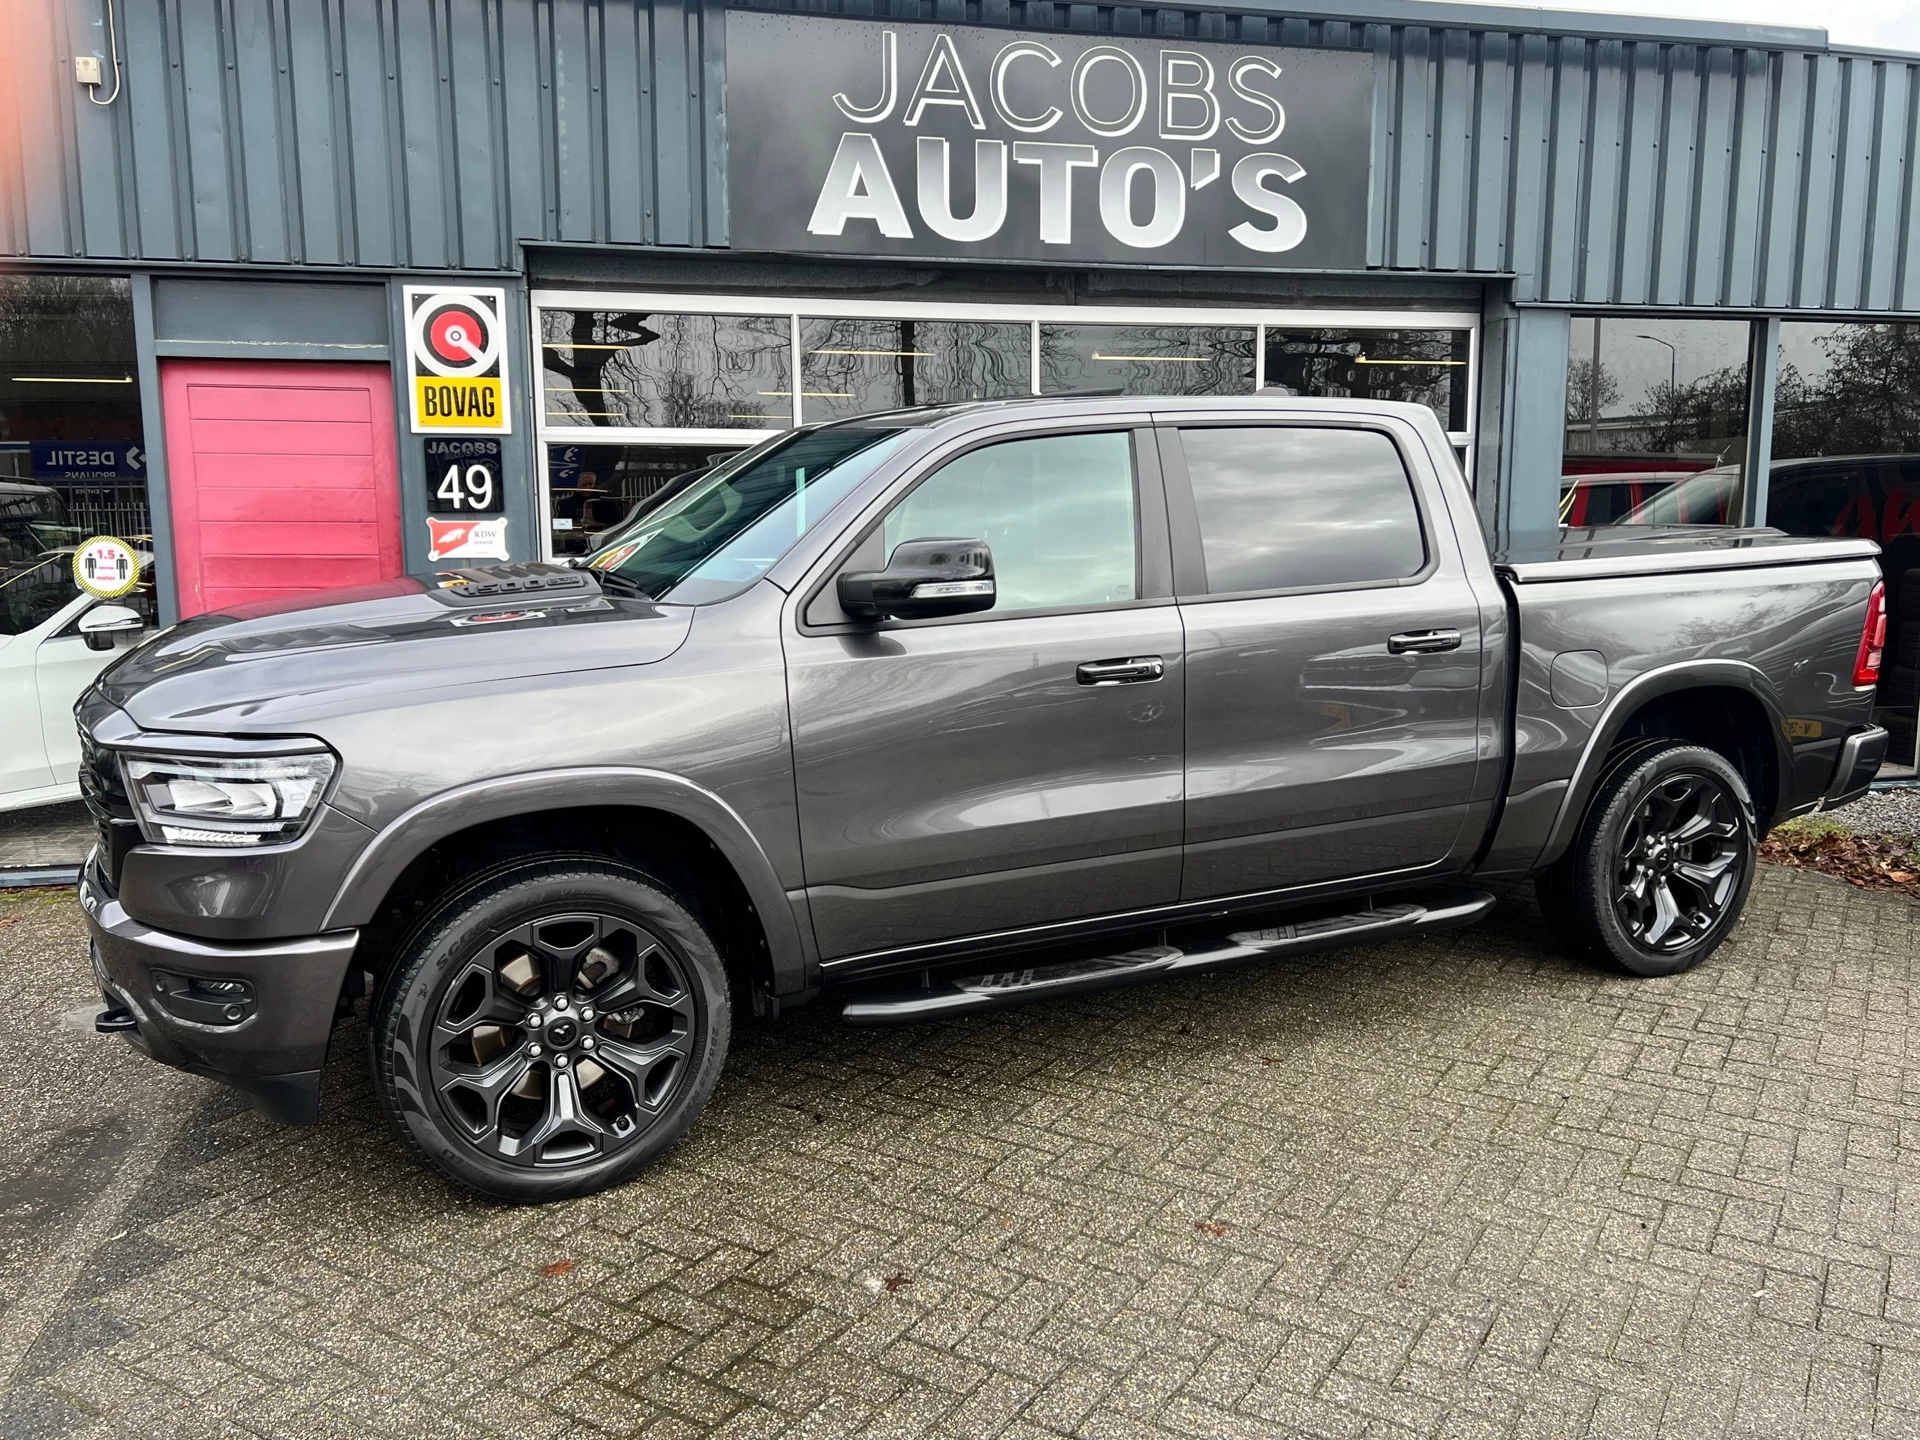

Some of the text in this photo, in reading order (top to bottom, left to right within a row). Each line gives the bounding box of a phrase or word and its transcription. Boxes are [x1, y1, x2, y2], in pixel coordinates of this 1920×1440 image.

[832, 31, 1286, 145] JACOBS
[807, 132, 1308, 253] AUTO'S
[424, 386, 495, 417] BOVAG
[427, 442, 498, 455] JACOBS
[437, 464, 492, 509] 49
[97, 549, 116, 560] 1.5
[463, 579, 546, 596] 1500
